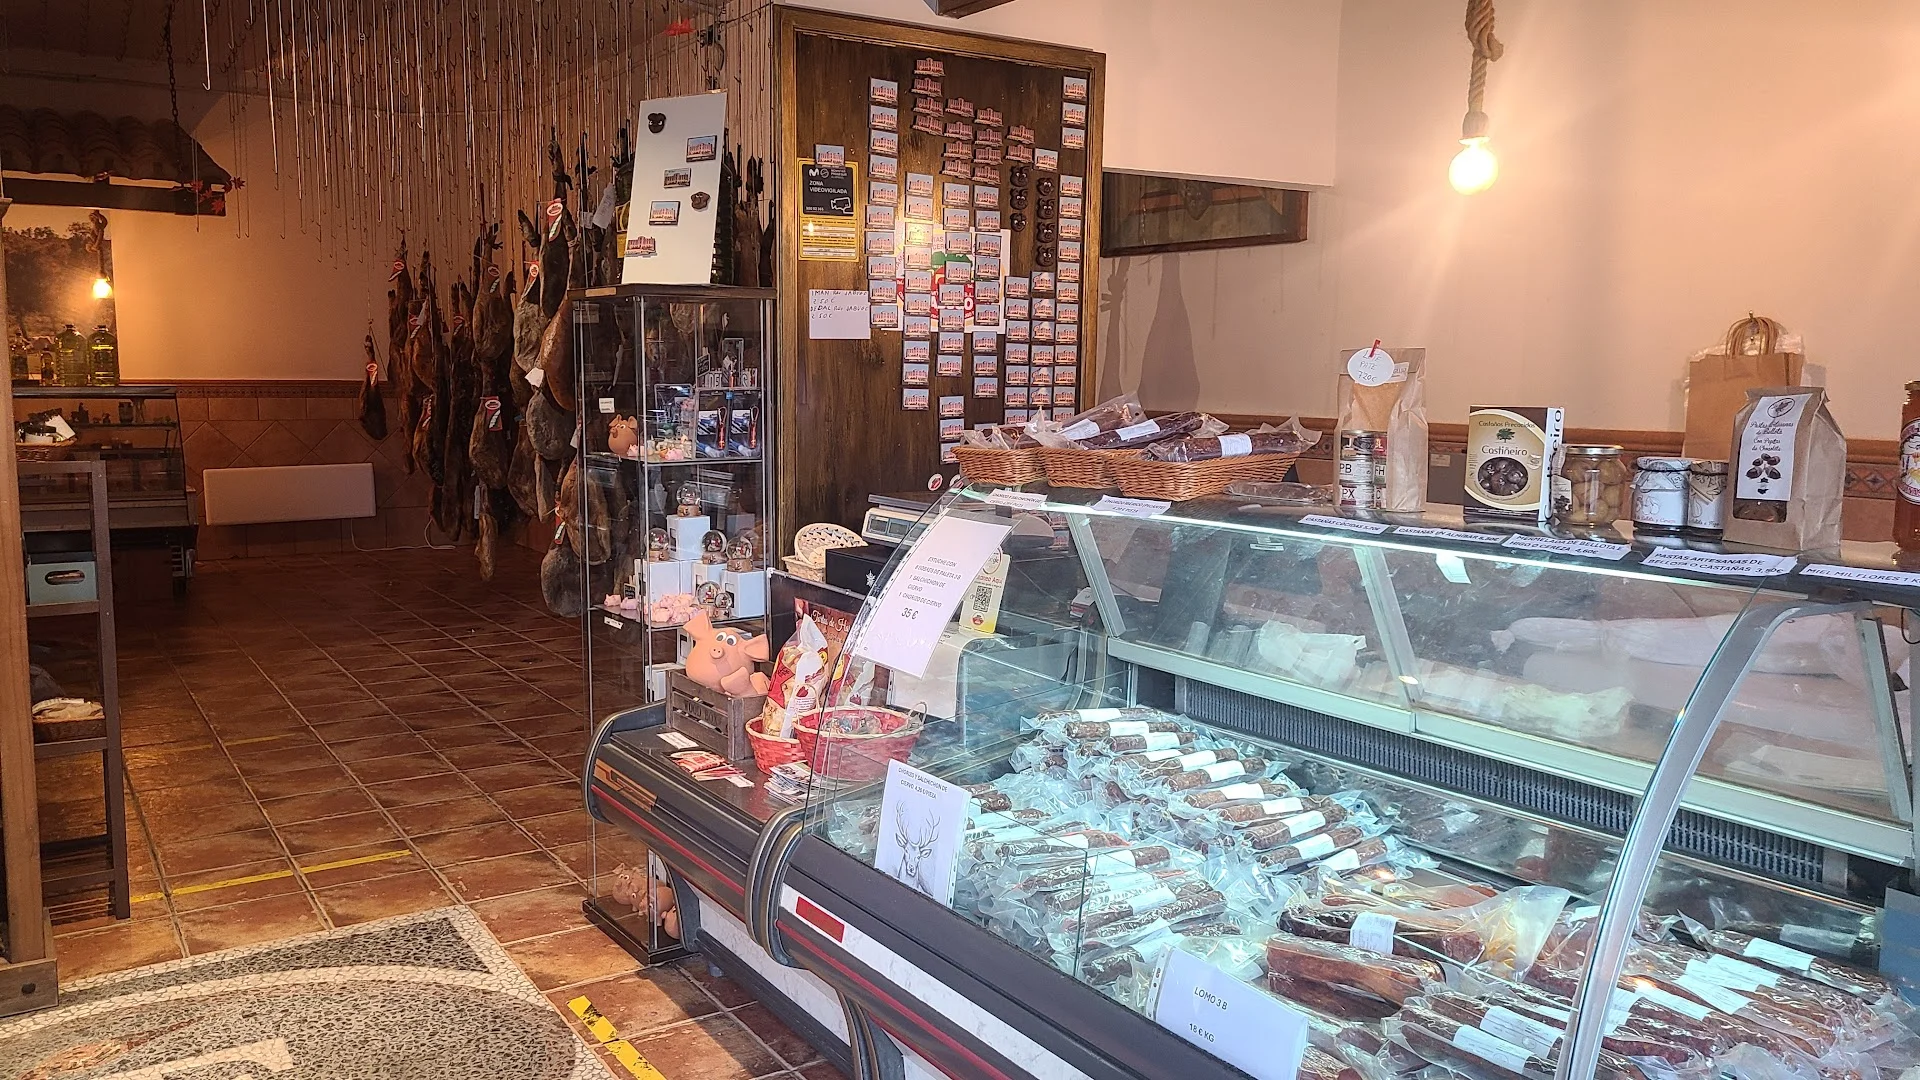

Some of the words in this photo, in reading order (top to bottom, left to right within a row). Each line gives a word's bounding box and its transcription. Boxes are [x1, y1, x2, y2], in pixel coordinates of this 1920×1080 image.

[809, 187, 848, 195] VIDEOVIGILADA
[1481, 444, 1528, 456] Castiñeiro
[1516, 536, 1566, 544] MERMELADA
[1579, 541, 1616, 549] BELLOTA
[1648, 559, 1688, 567] BELLOTA
[1654, 553, 1690, 561] PASTAS
[1689, 557, 1748, 565] ARTESANAS
[1856, 573, 1901, 581] FLORES
[907, 584, 923, 592] CIERVO
[901, 607, 912, 618] 35
[912, 610, 919, 619] €
[1194, 986, 1216, 1004] LOMO
[1216, 999, 1222, 1007] 3
[1221, 1002, 1228, 1010] B
[1189, 1023, 1198, 1033] 18
[1197, 1028, 1203, 1036] €
[1204, 1031, 1215, 1043] KG
